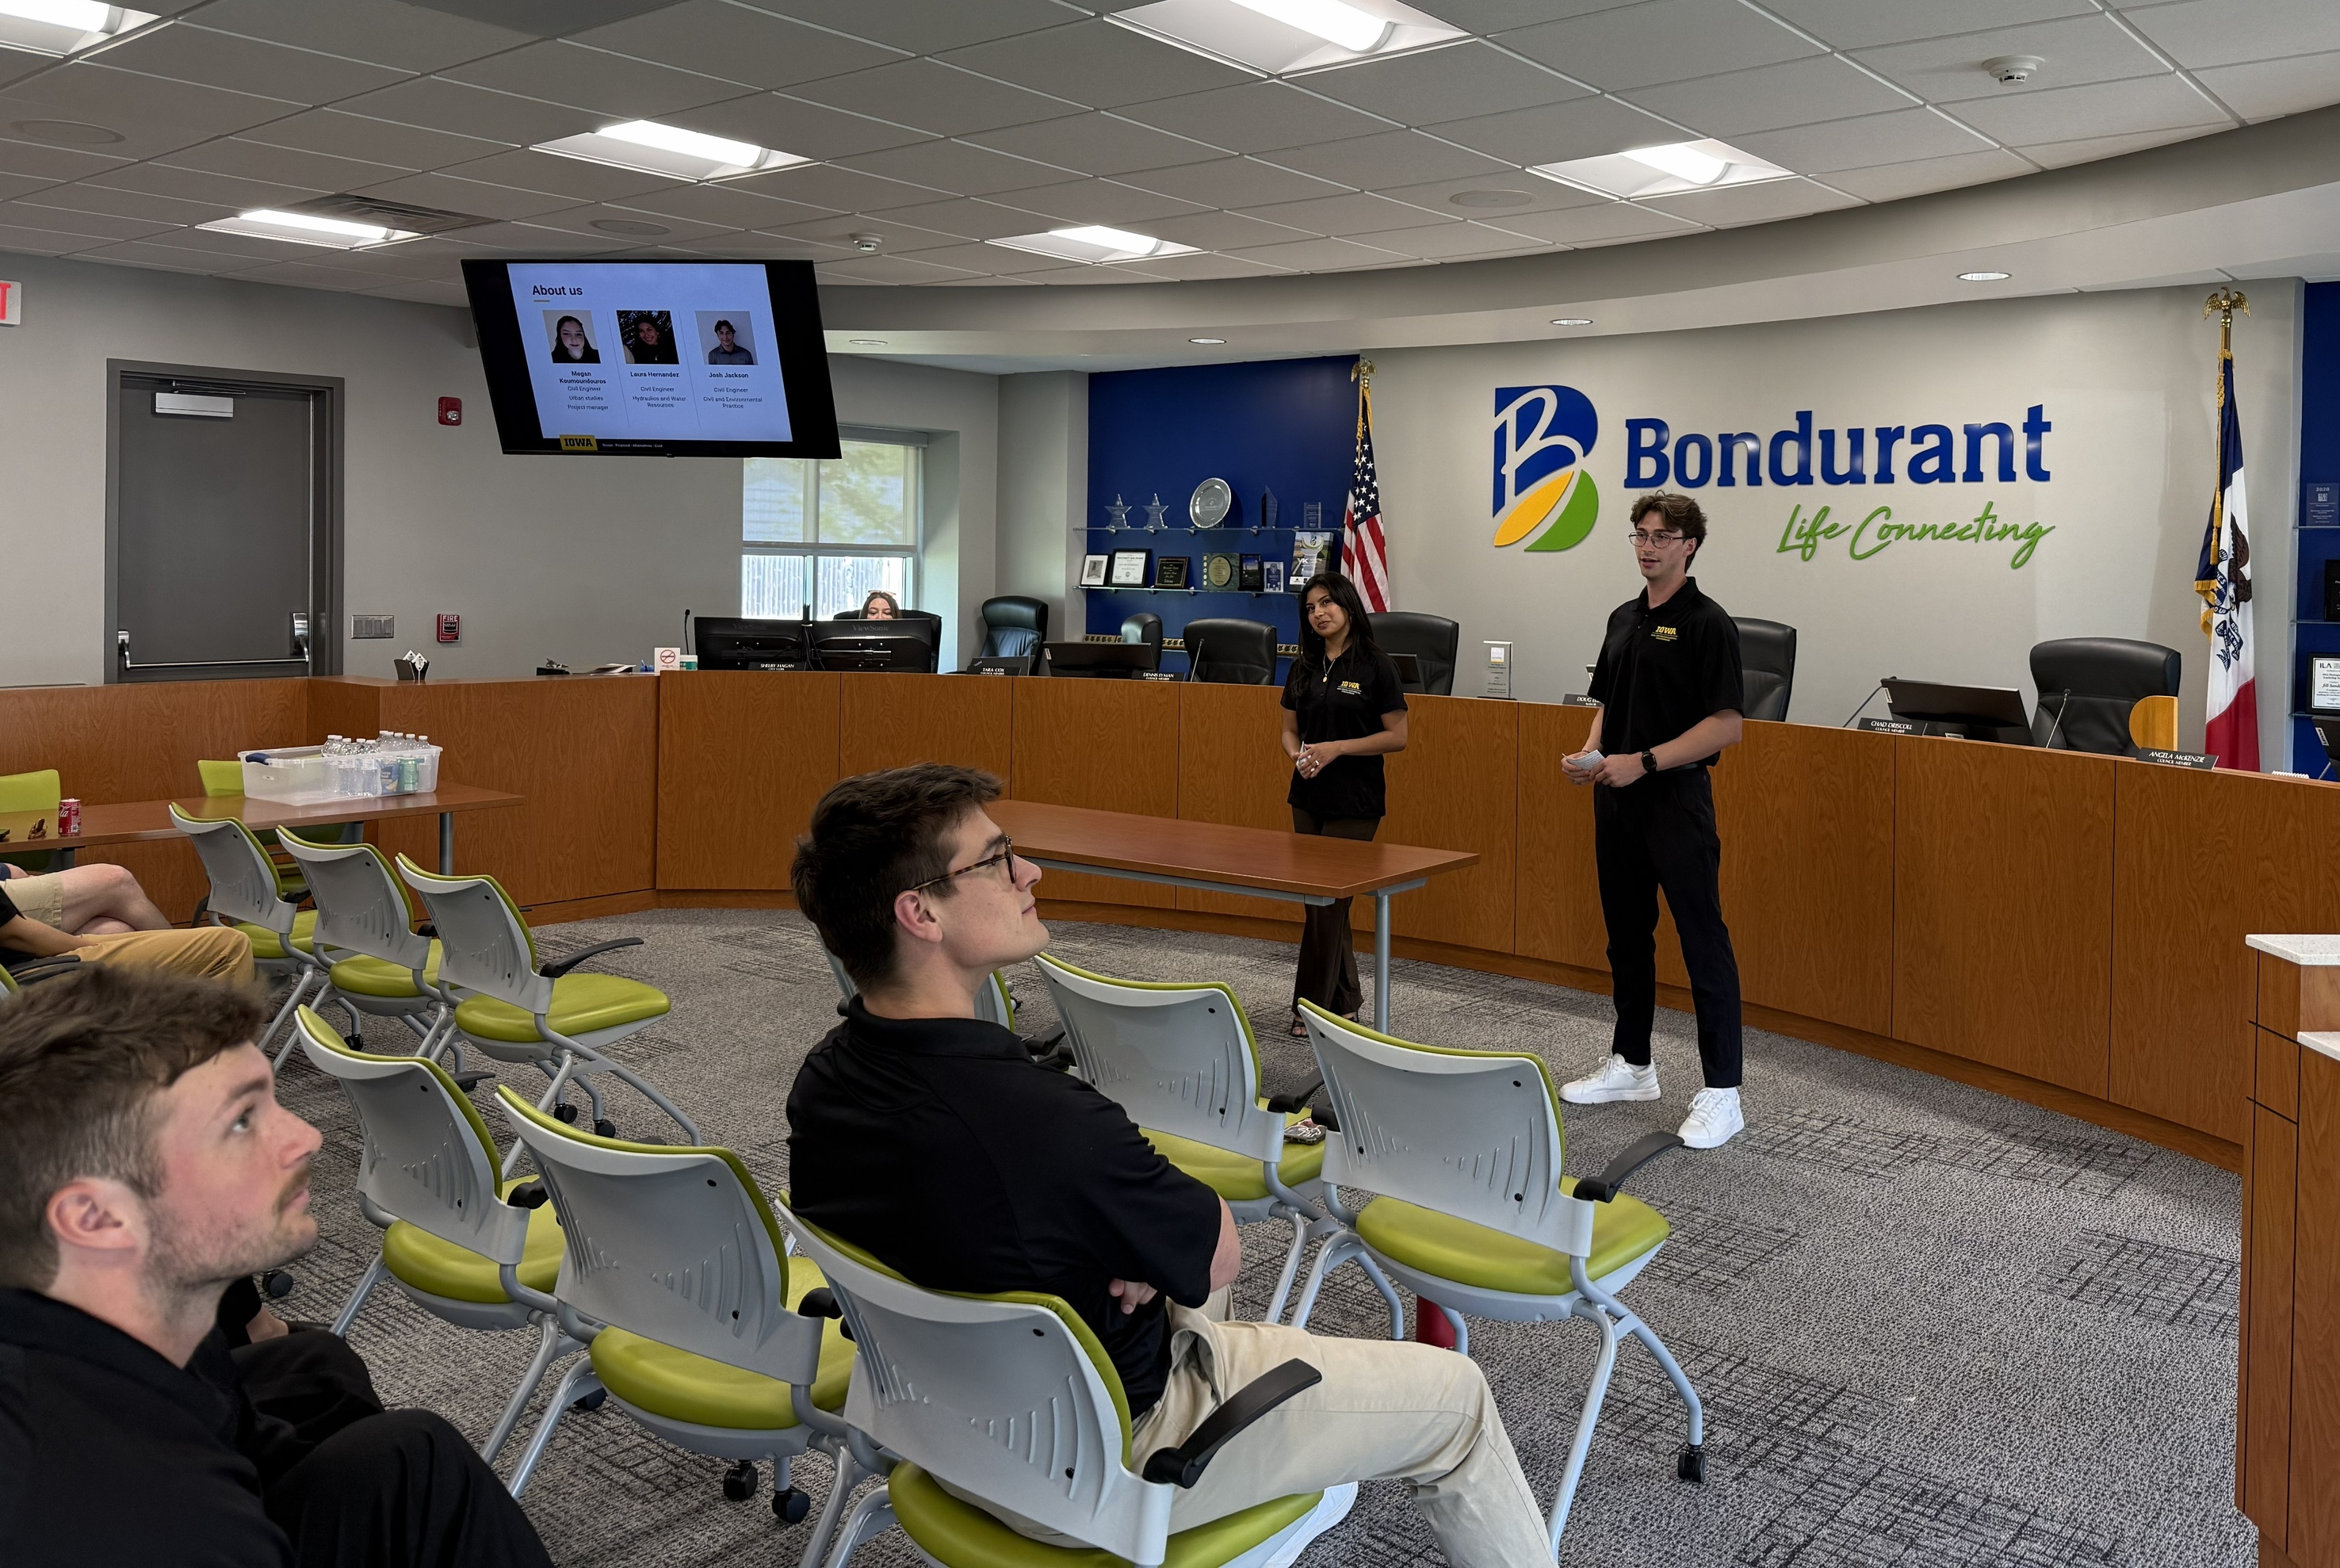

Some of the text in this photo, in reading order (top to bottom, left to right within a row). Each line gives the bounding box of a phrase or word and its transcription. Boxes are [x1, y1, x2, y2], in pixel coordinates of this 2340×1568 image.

[532, 285, 583, 296] About us
[564, 438, 594, 447] IOWA
[1623, 403, 2051, 489] Bondurant
[1776, 500, 2057, 569] Life Connecting
[1655, 625, 1677, 635] IOWA
[1340, 681, 1360, 690] IOWA
[2148, 751, 2174, 759] ANGELA
